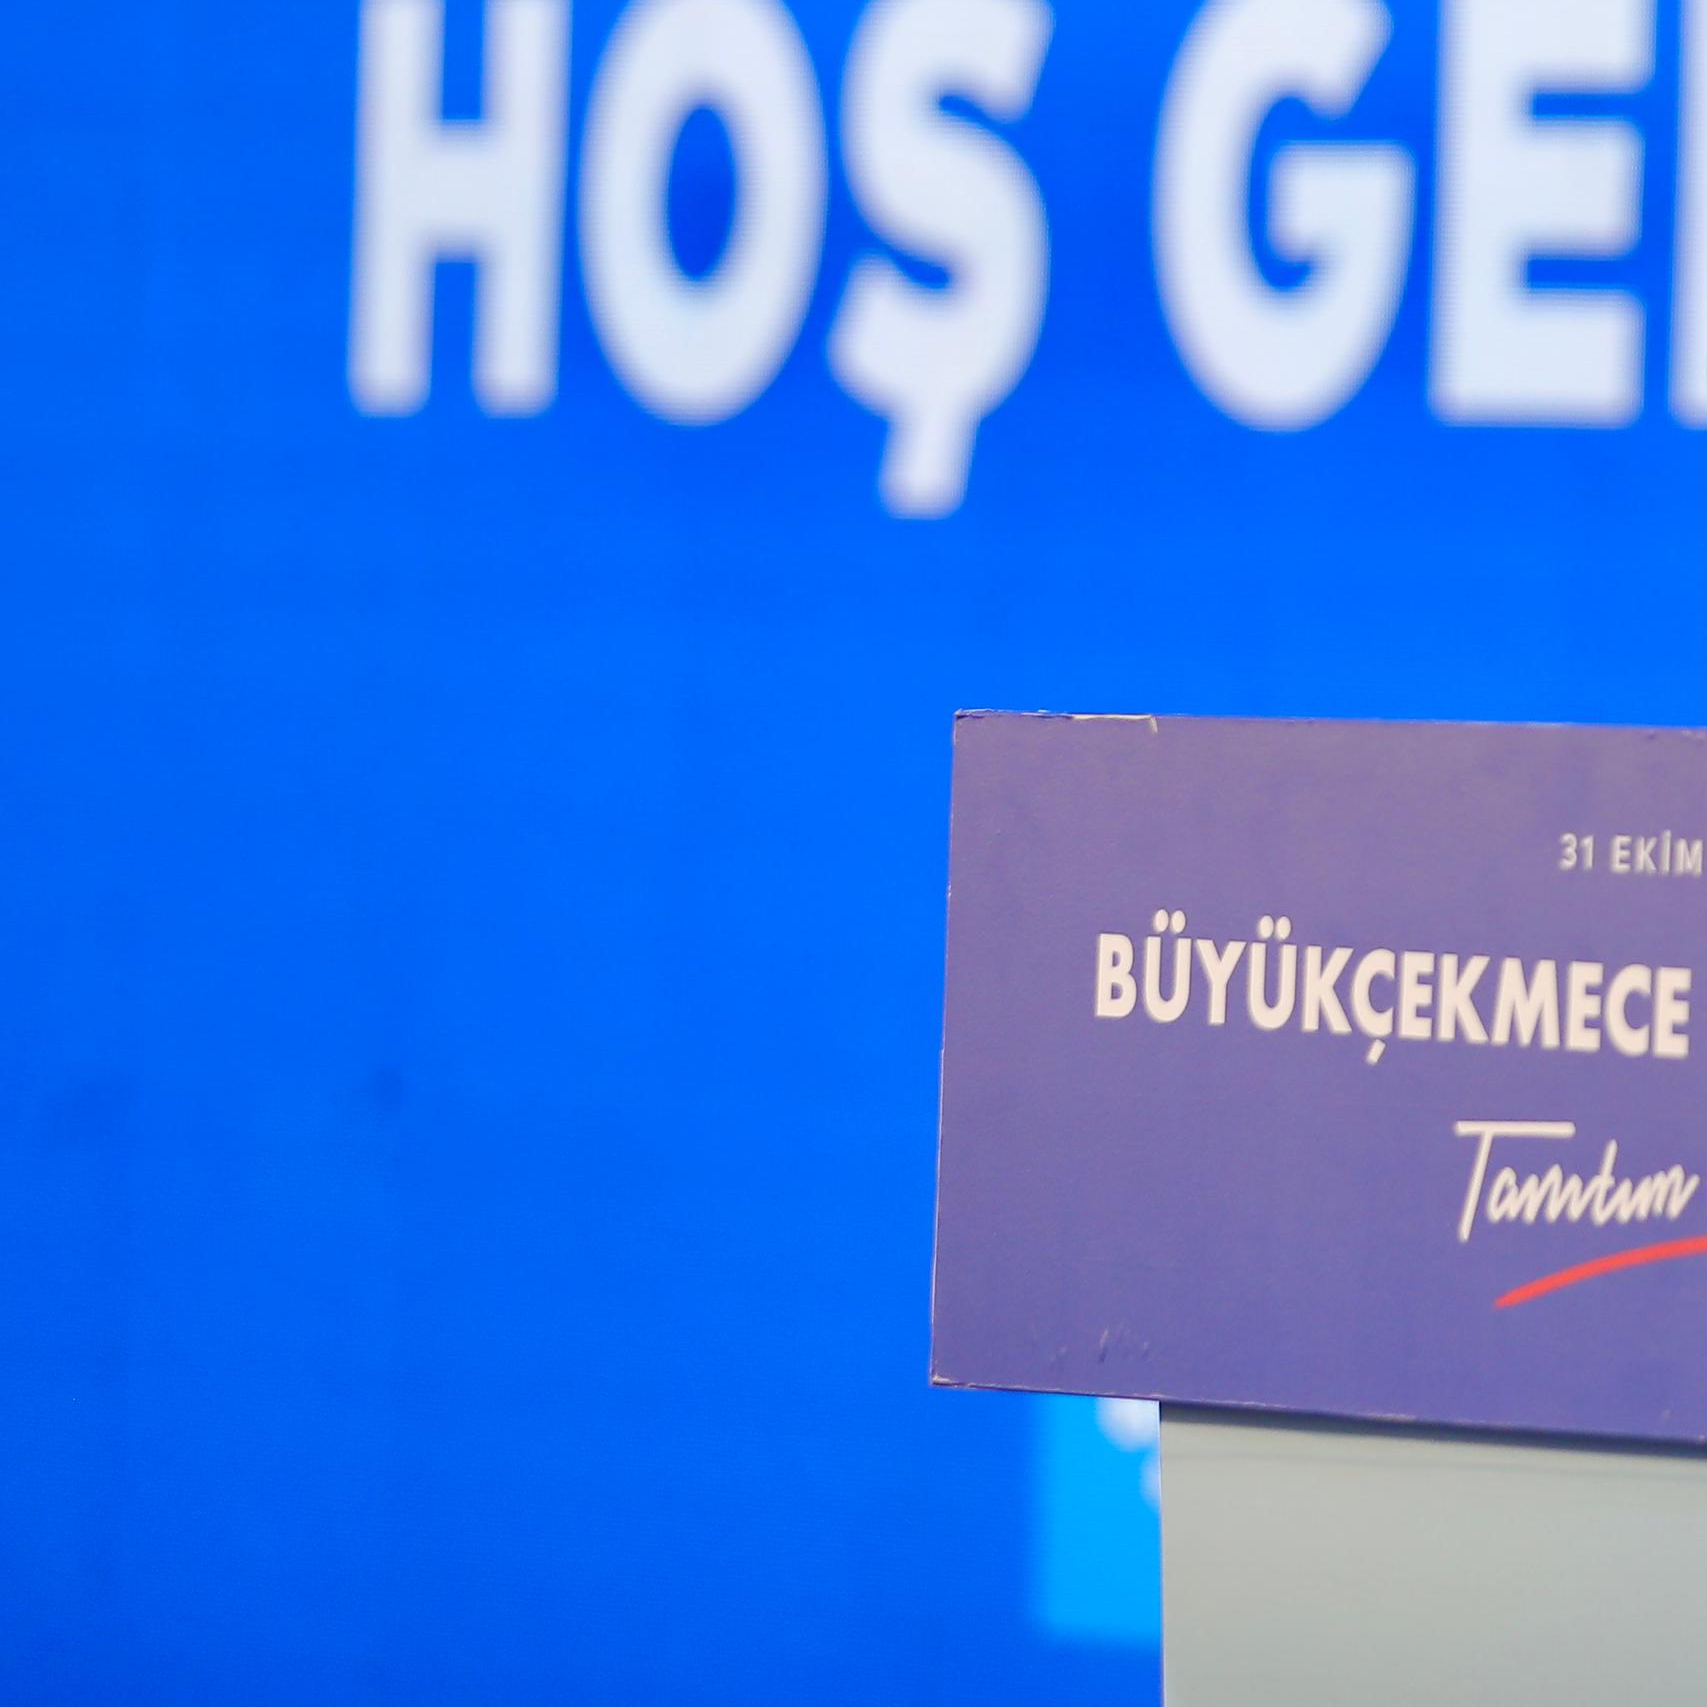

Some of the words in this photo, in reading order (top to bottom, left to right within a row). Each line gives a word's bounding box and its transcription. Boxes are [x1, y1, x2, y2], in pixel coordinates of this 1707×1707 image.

[1558, 832, 1595, 871] 31
[1610, 829, 1704, 877] EKİM
[1093, 908, 1692, 1065] BÜYÜKÇEKMECE
[1453, 1119, 1701, 1243] Tanıtım
